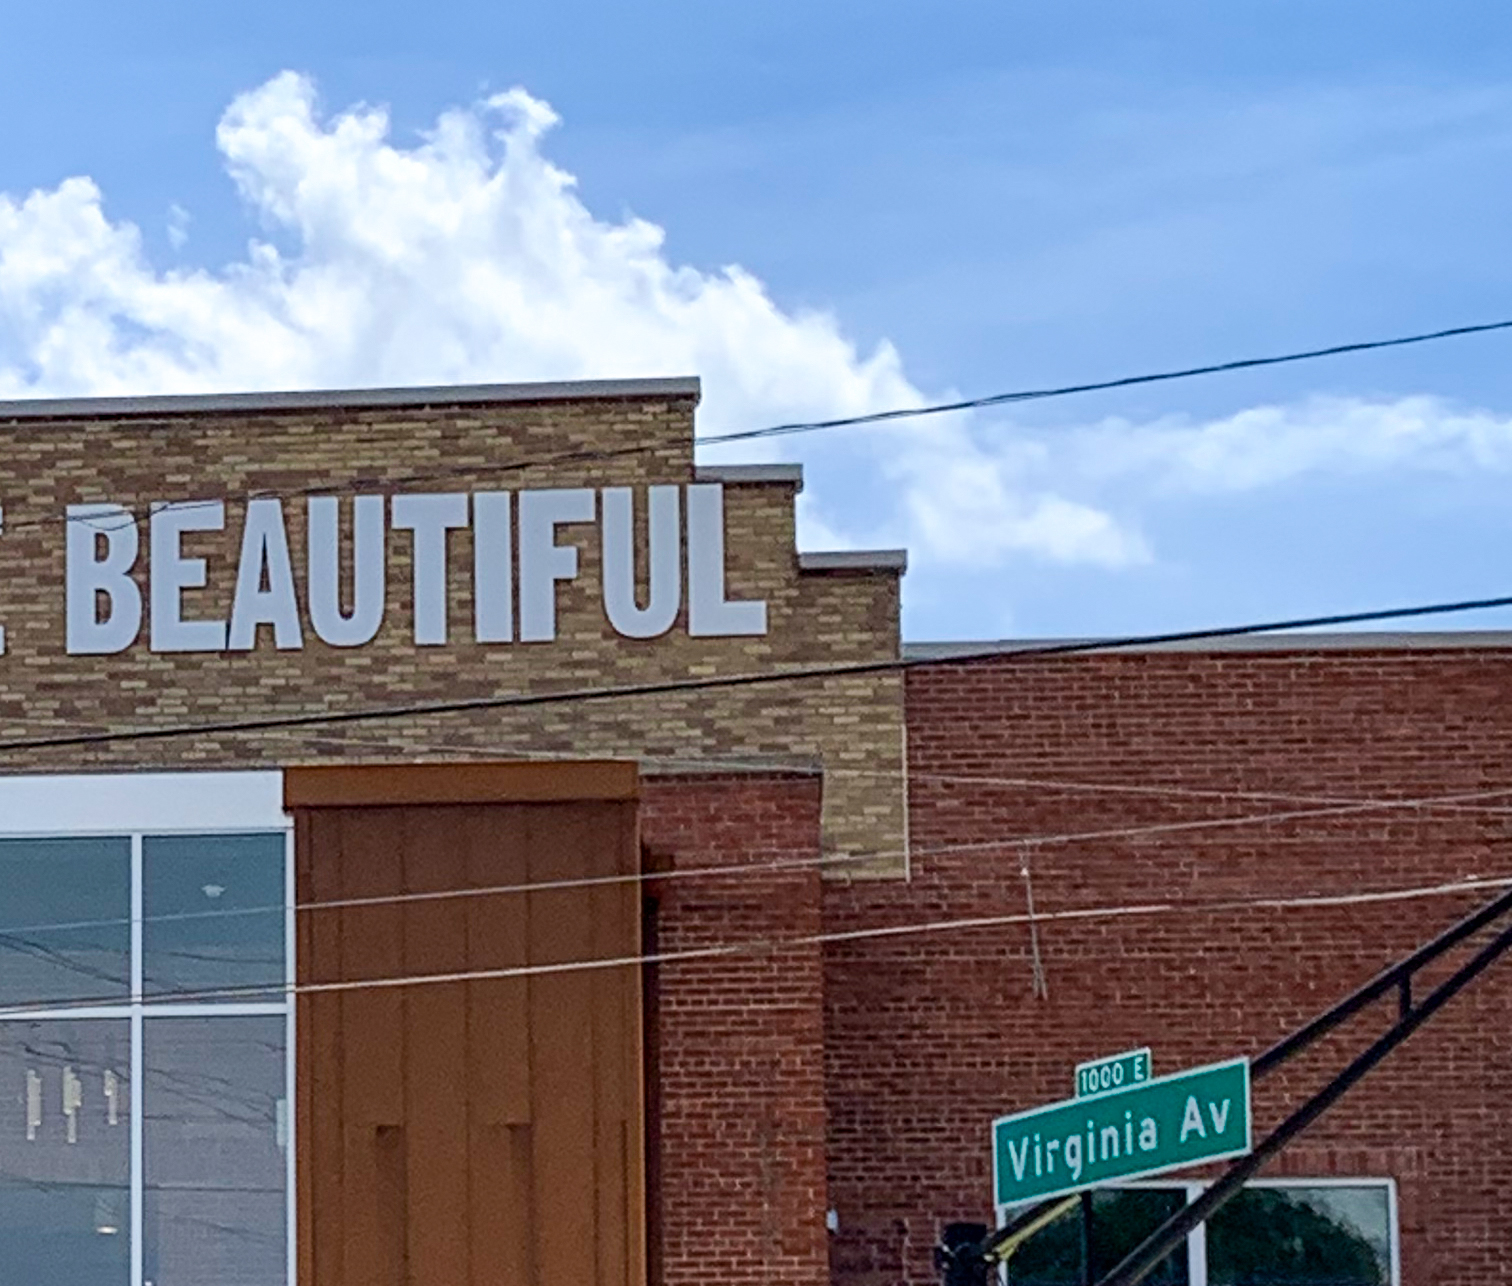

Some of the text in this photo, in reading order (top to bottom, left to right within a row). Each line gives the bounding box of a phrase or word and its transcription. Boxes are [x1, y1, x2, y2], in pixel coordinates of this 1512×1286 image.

[65, 483, 769, 656] BEAUTIFUL
[1080, 1056, 1145, 1093] 1000 E
[1007, 1095, 1232, 1182] Virginia Av
